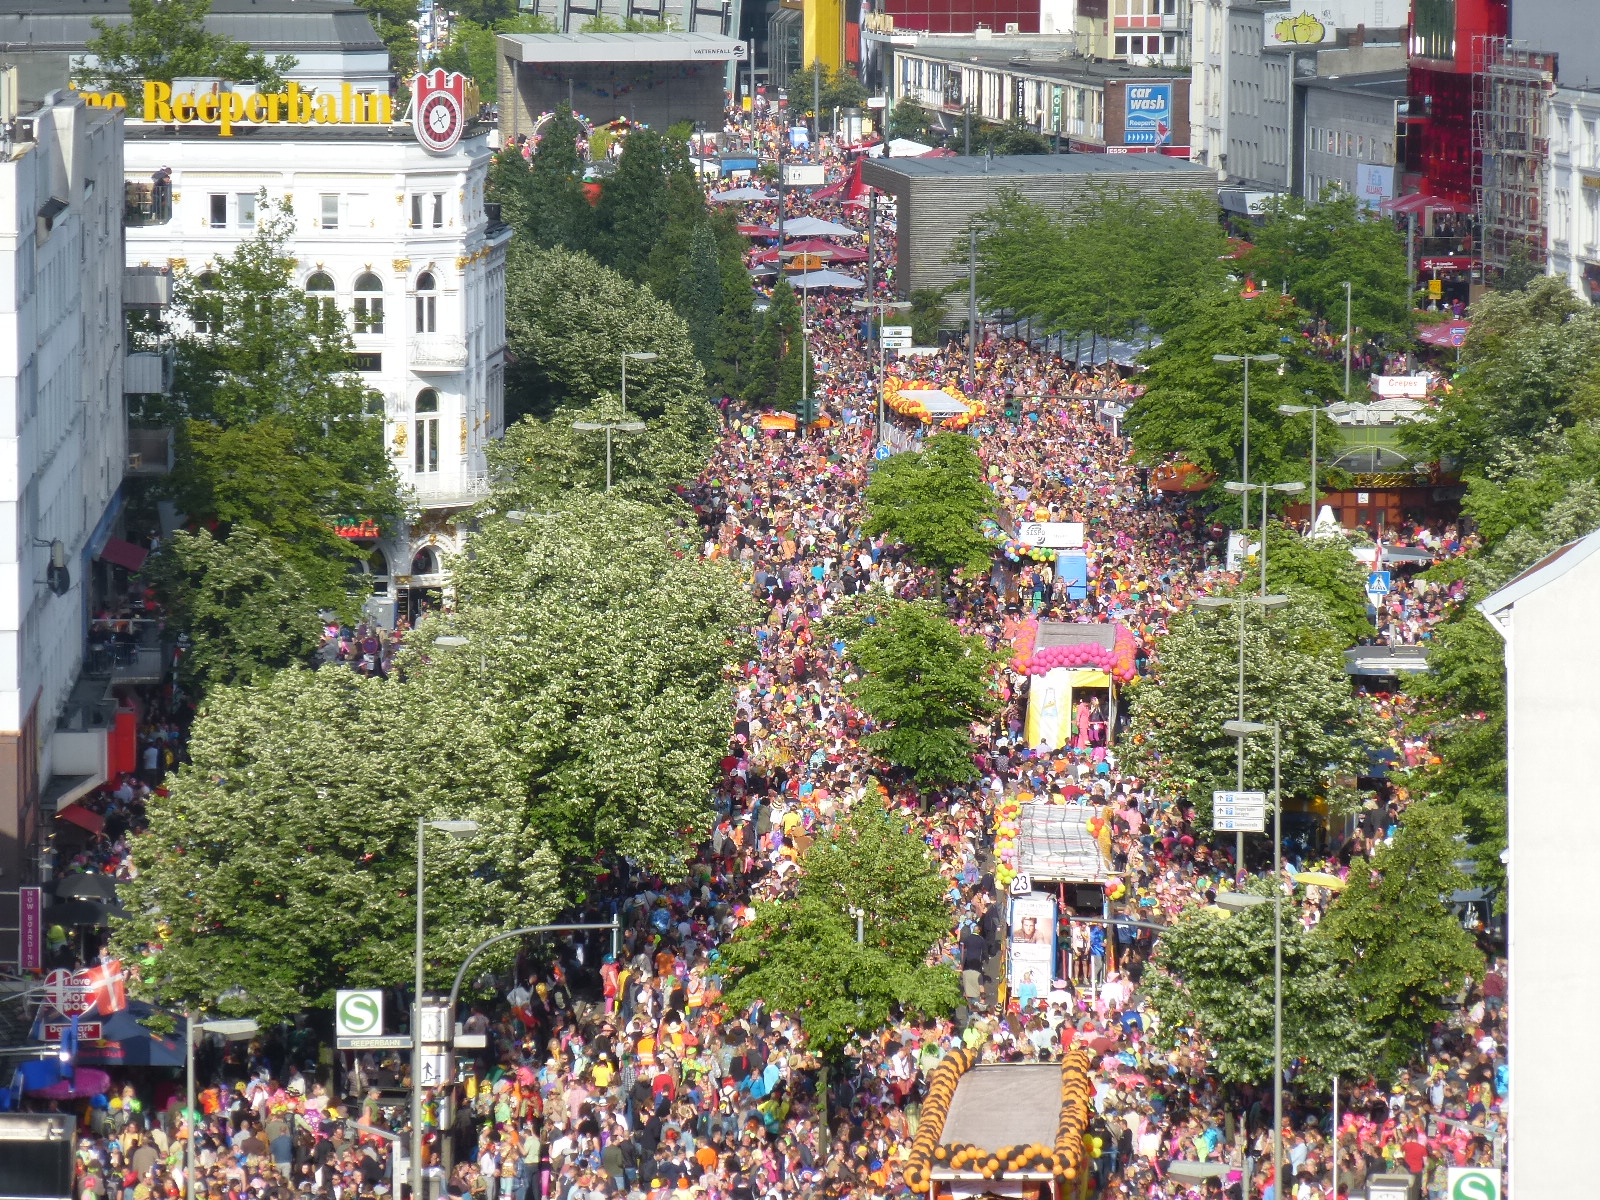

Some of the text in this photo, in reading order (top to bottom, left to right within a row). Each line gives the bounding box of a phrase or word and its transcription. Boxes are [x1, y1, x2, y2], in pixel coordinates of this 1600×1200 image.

[1131, 88, 1152, 98] car
[142, 80, 393, 136] Reeperbahn
[1131, 95, 1165, 109] wash
[1012, 875, 1029, 891] 23
[345, 996, 375, 1031] S
[49, 1025, 94, 1033] Daark
